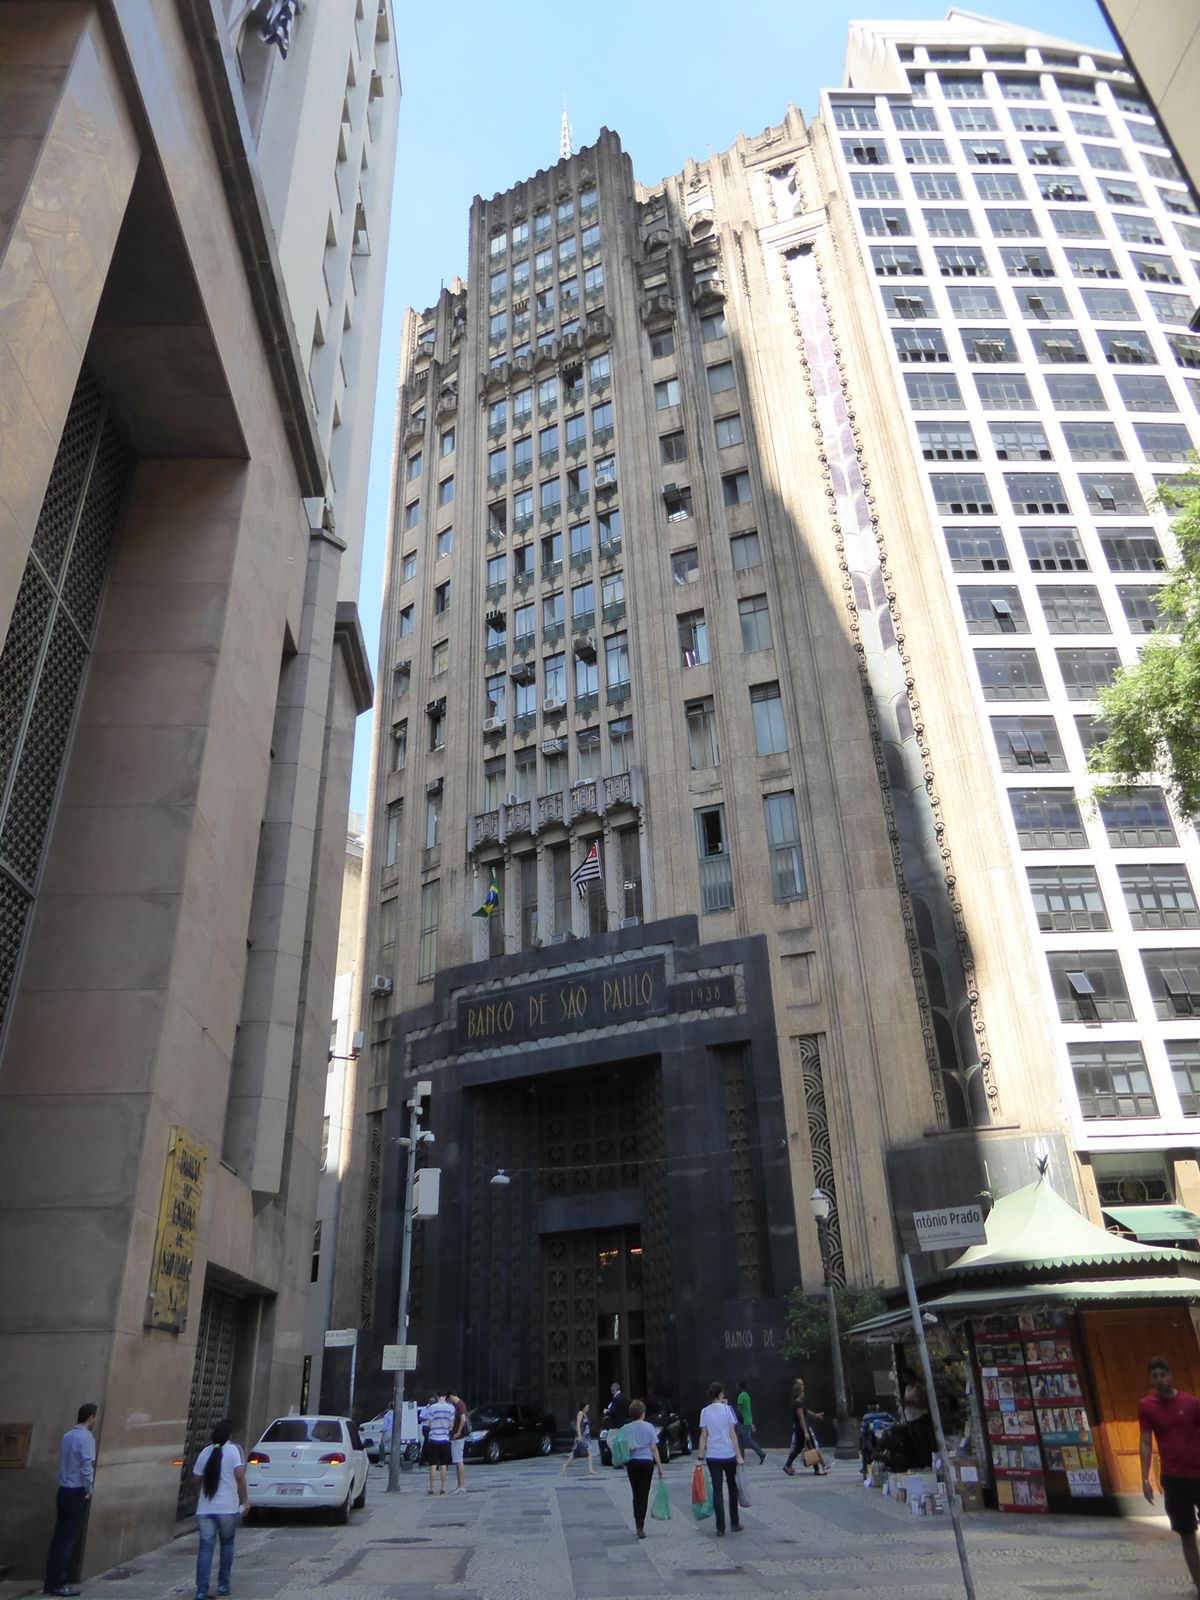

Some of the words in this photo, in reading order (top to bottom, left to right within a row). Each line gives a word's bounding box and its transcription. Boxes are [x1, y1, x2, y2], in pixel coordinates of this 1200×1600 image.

[690, 984, 720, 1005] 1938
[467, 1000, 514, 1040] BANCO
[529, 993, 547, 1027] DE
[560, 981, 587, 1020] SÃO
[603, 971, 653, 1012] PAULO
[949, 1208, 980, 1225] Prado
[724, 1329, 753, 1349] BANCO
[763, 1328, 775, 1347] DE
